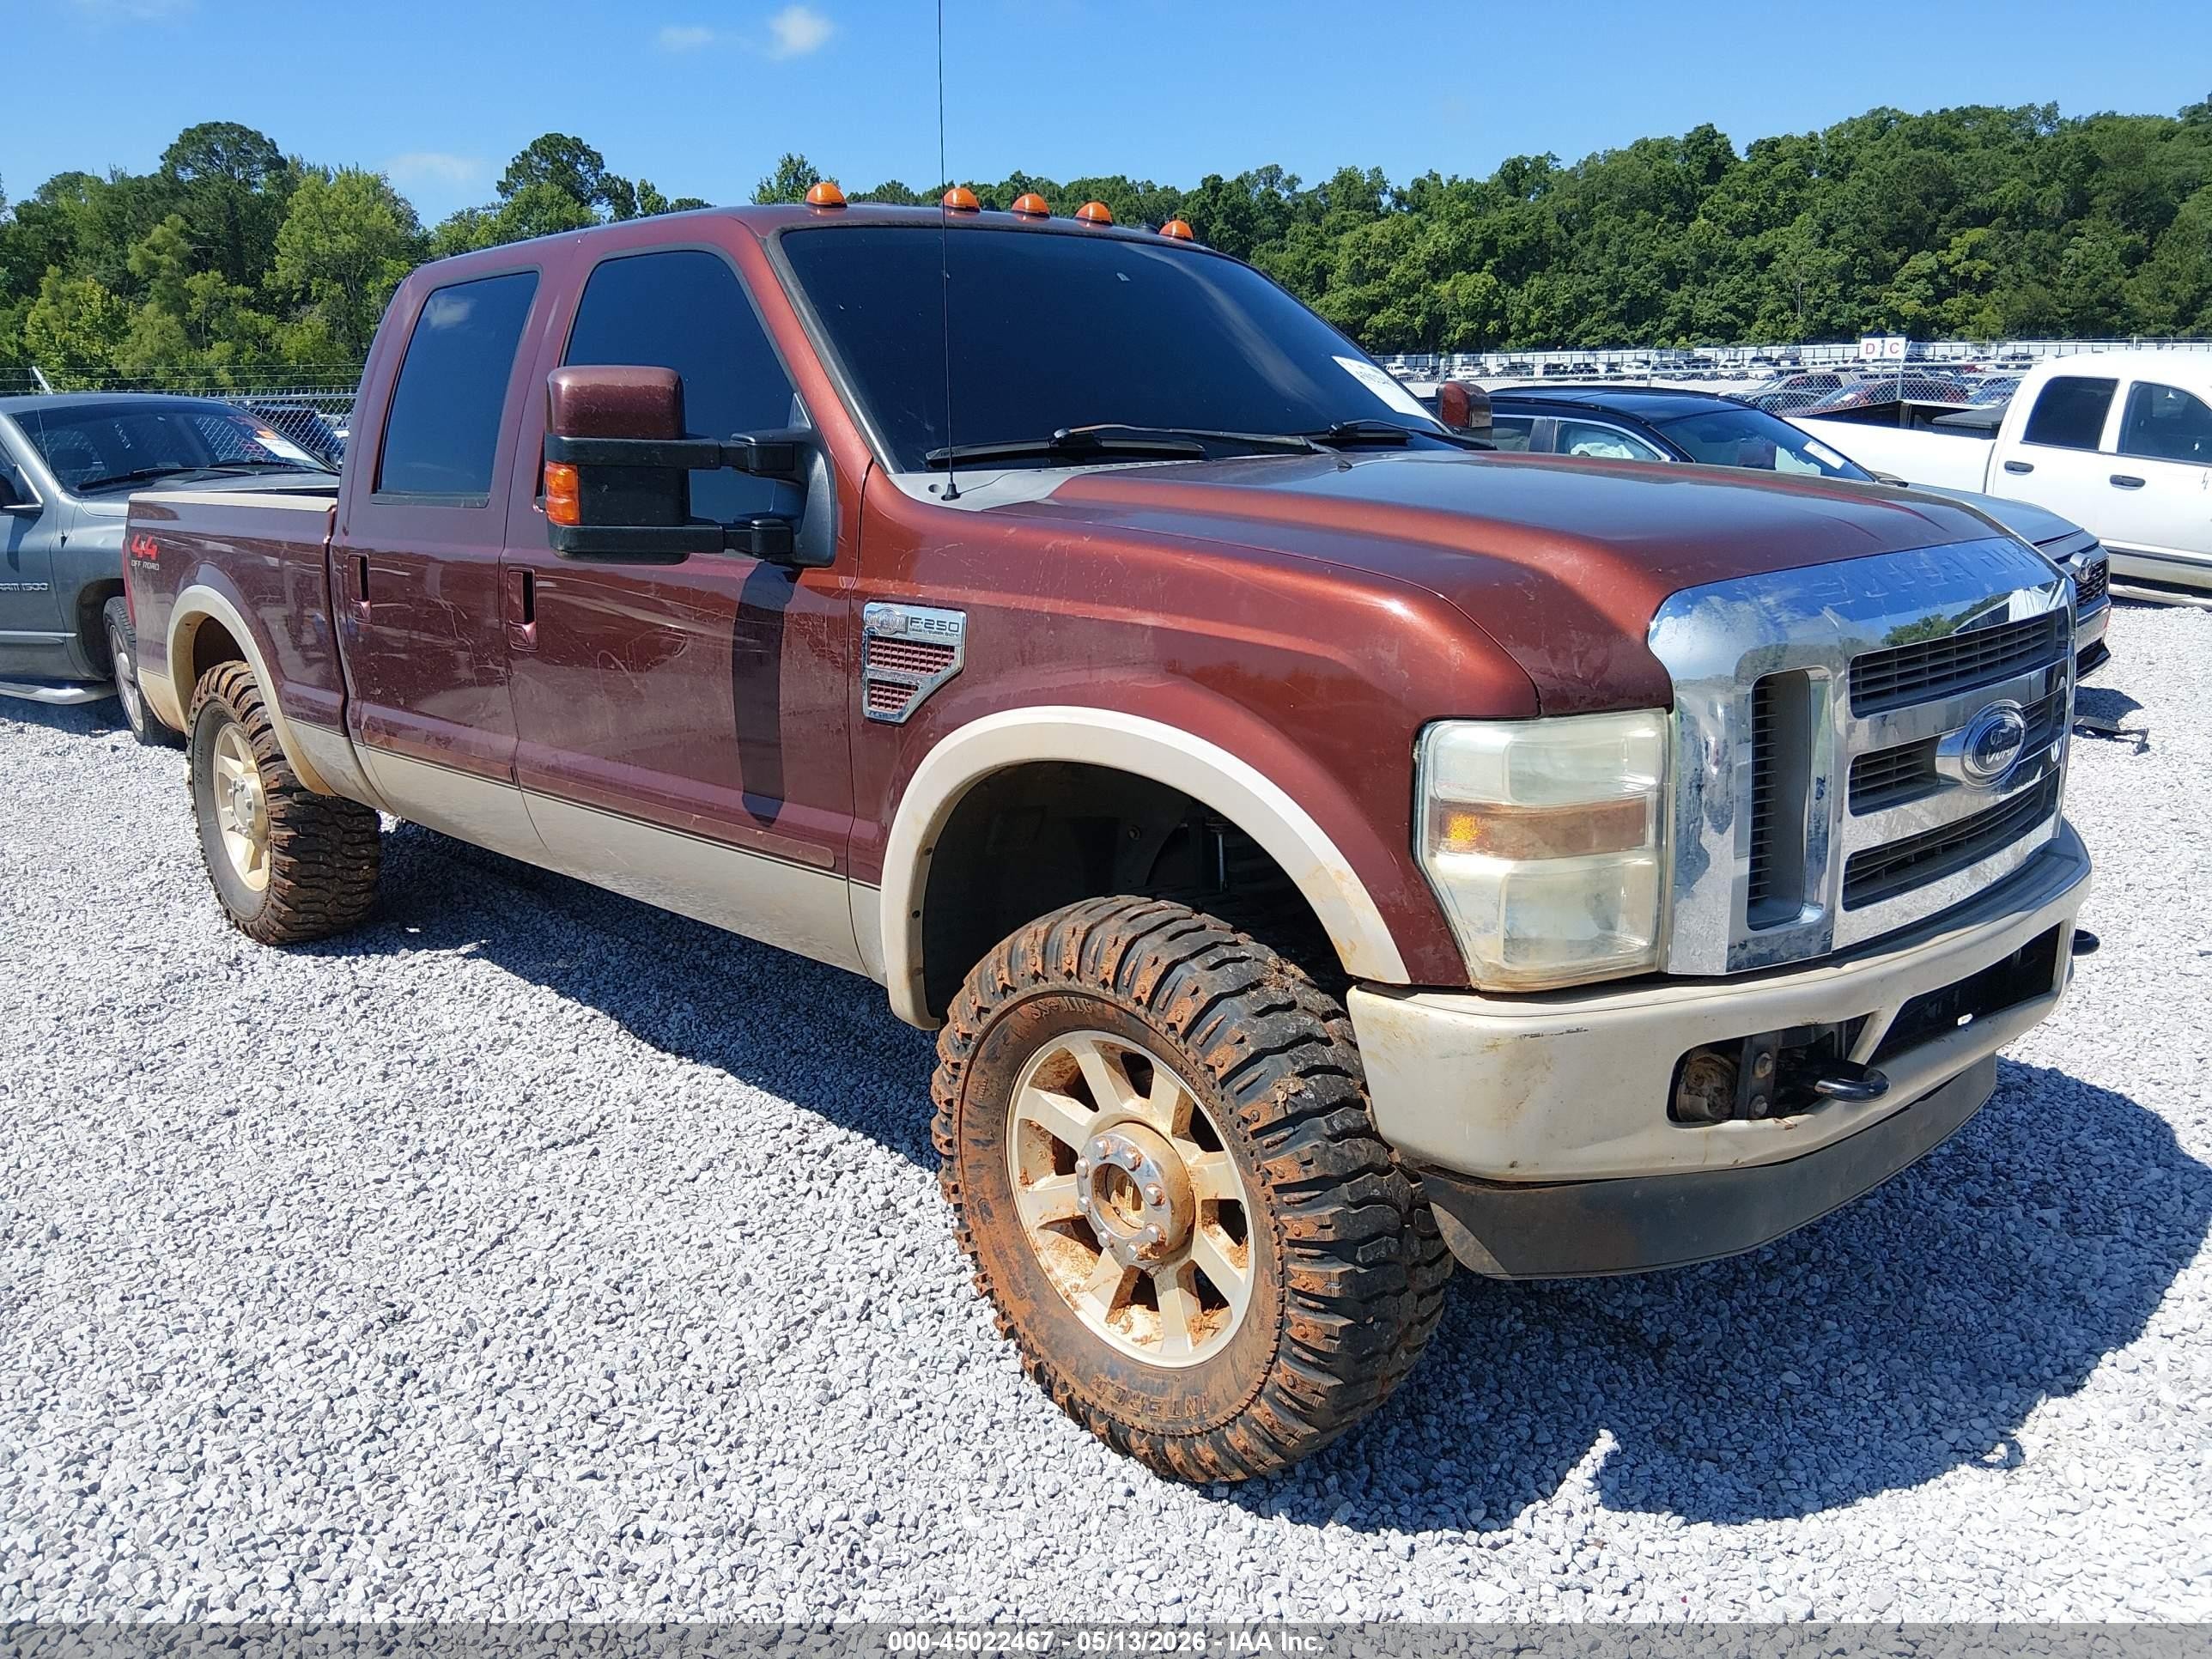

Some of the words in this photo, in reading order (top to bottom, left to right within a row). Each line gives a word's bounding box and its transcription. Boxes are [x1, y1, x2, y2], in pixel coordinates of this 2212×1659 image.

[1865, 343, 1875, 355] D
[1889, 342, 1900, 355] C
[131, 559, 142, 568] OFF
[143, 561, 160, 571] ROAD
[21, 582, 49, 592] 1500
[910, 617, 960, 634] F-250
